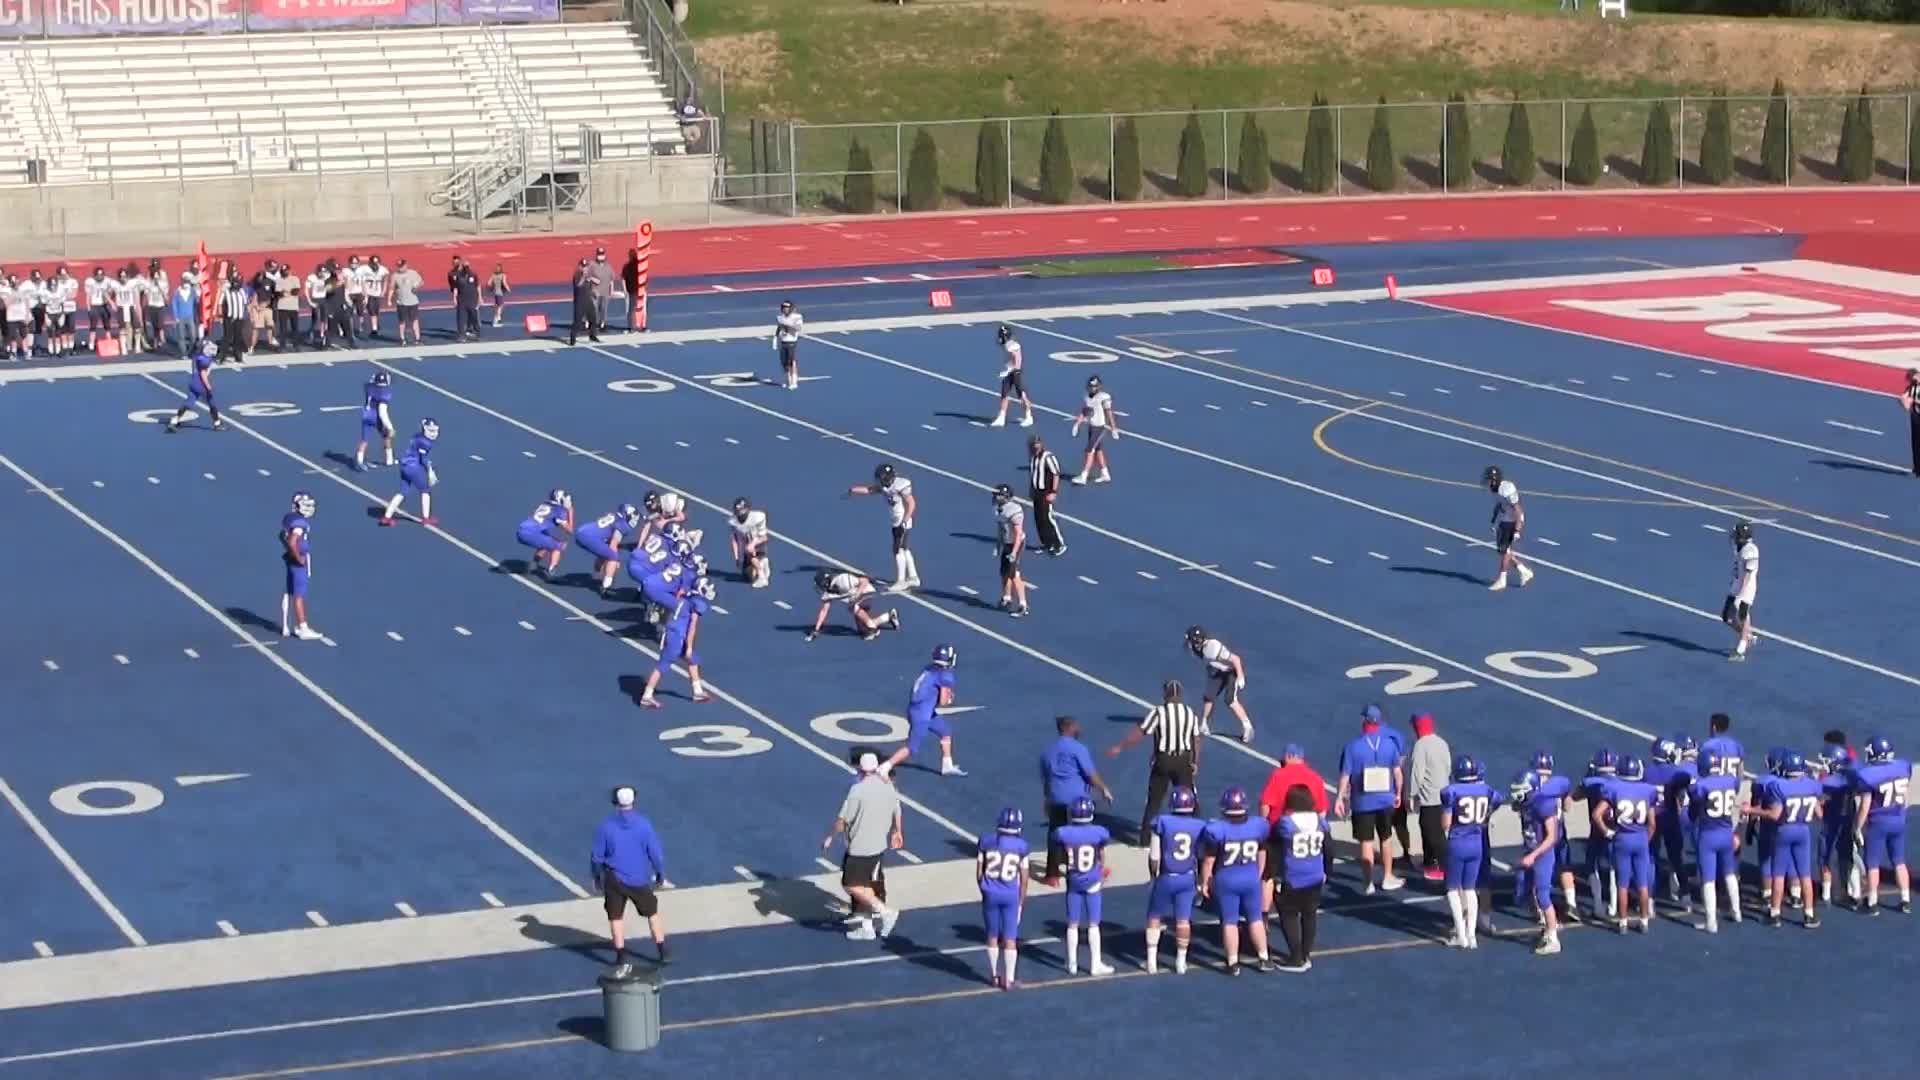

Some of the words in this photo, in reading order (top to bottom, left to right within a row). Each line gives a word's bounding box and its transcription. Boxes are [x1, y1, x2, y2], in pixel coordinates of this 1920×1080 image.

[1880, 779, 1909, 808] 75
[1458, 797, 1488, 824] 30
[1617, 800, 1648, 824] 21
[1786, 797, 1817, 823] 77
[1172, 832, 1191, 861] 3
[1223, 840, 1259, 866] 79
[985, 850, 1020, 881] 26
